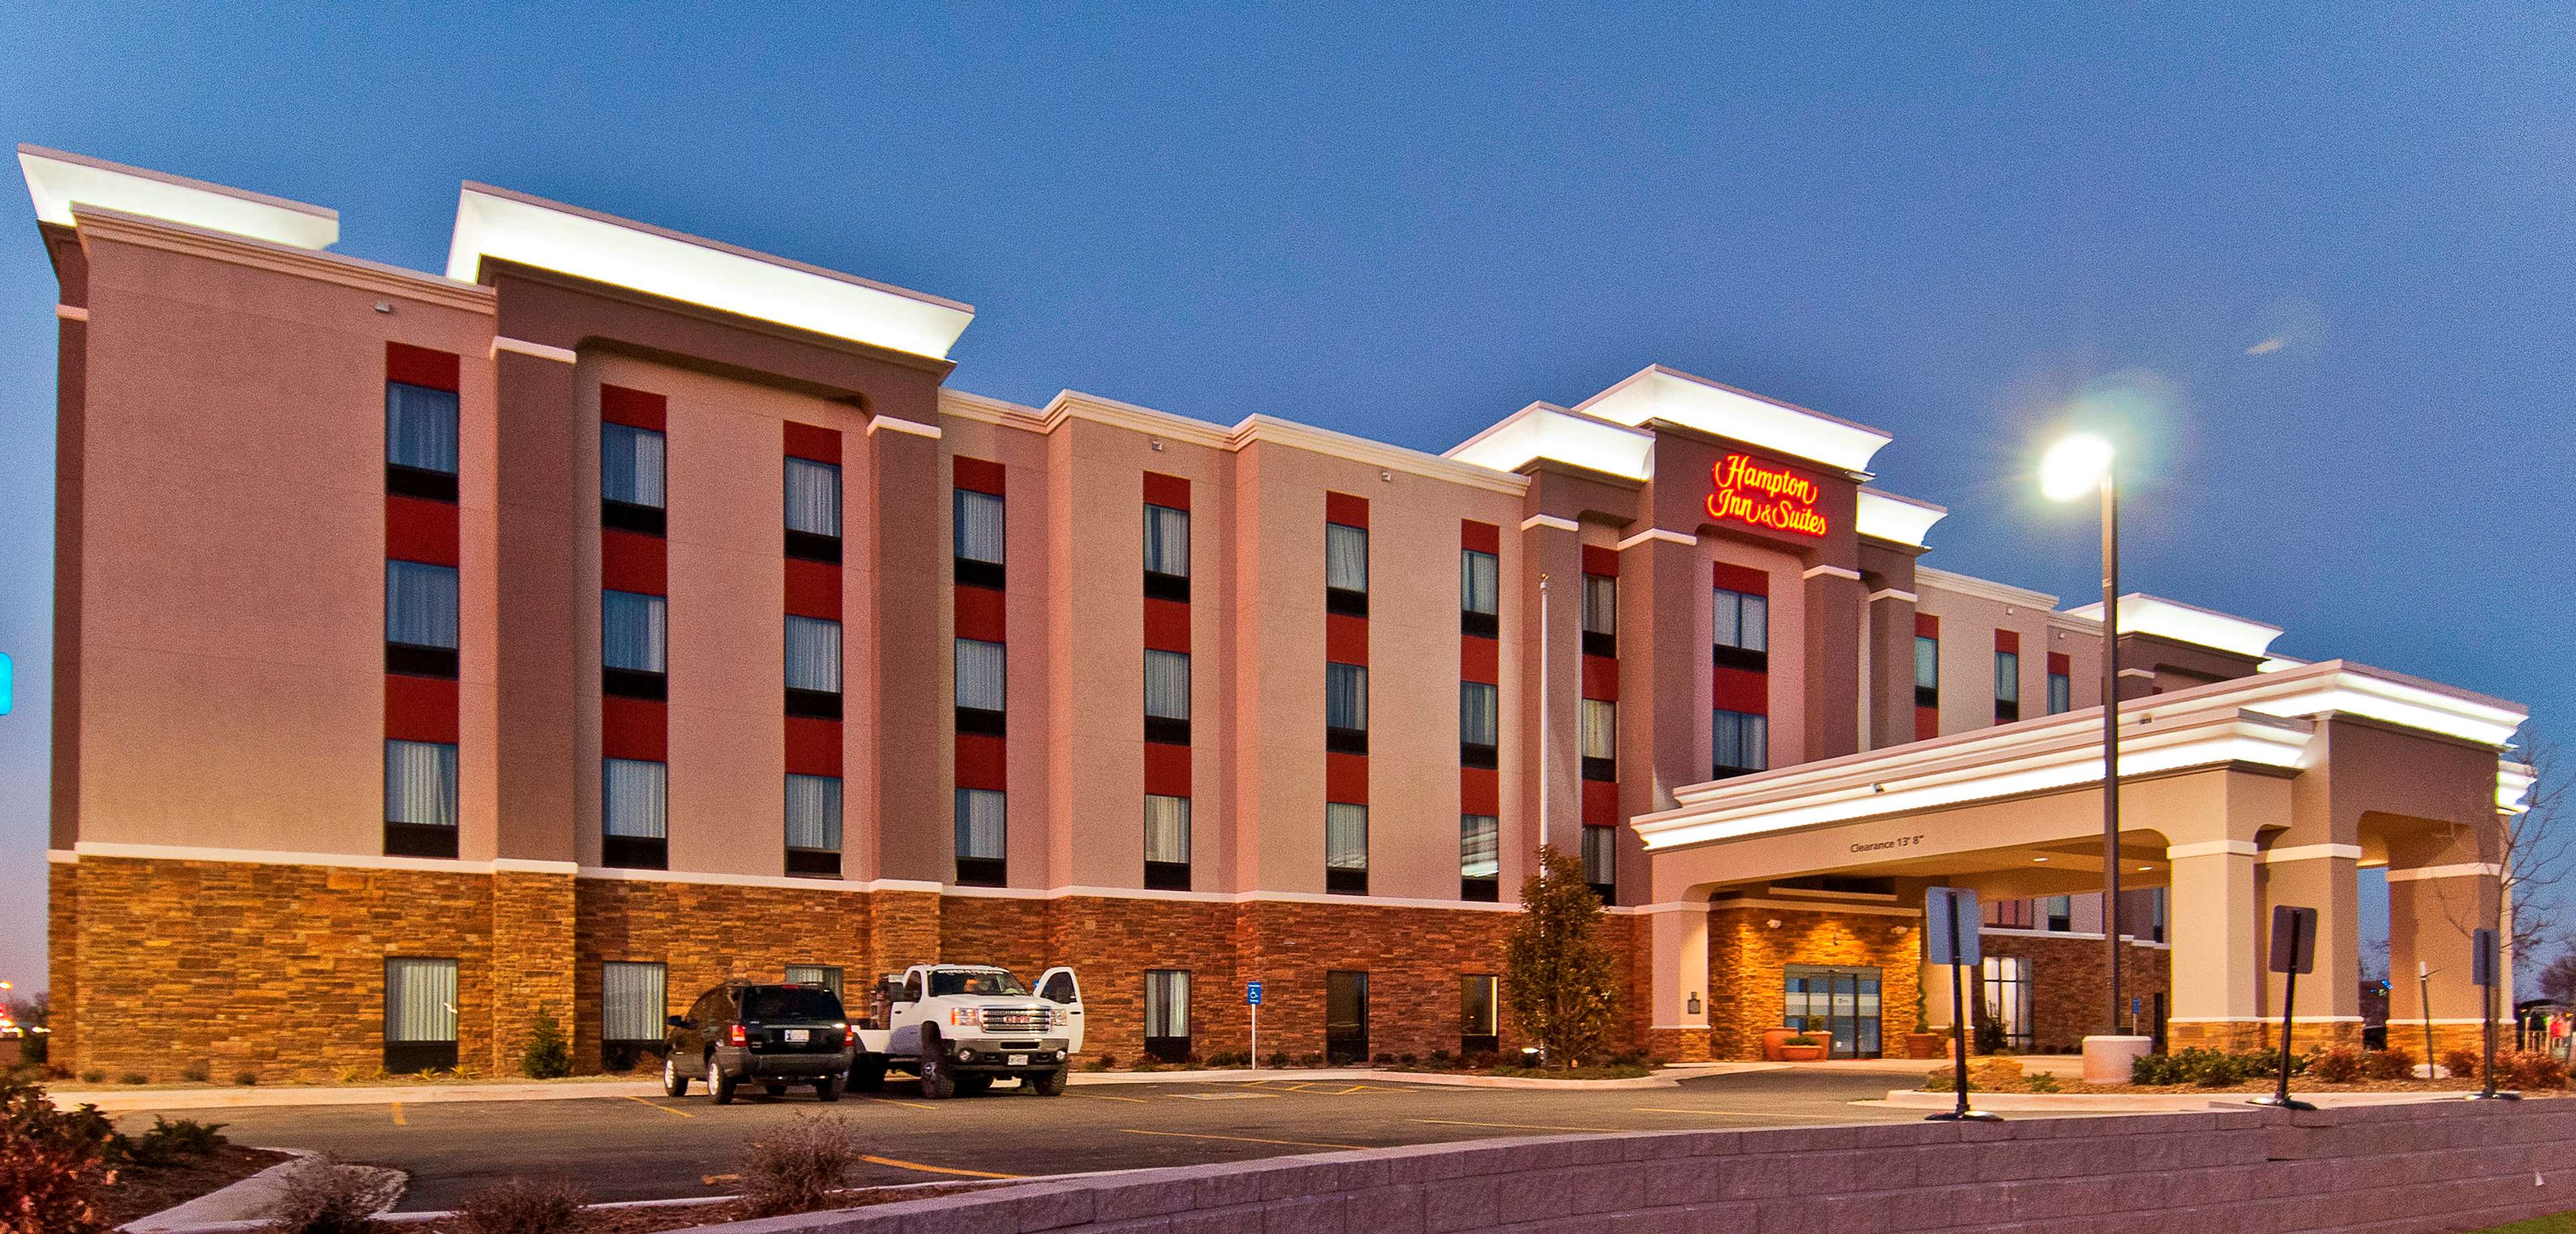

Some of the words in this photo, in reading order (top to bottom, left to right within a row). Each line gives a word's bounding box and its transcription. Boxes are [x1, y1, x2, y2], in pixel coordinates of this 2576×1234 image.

[1714, 455, 1818, 505] Hampton
[1707, 489, 1761, 523] Inn
[1761, 504, 1773, 527] &
[1772, 500, 1827, 535] Suites
[1850, 841, 1895, 853] Clearance
